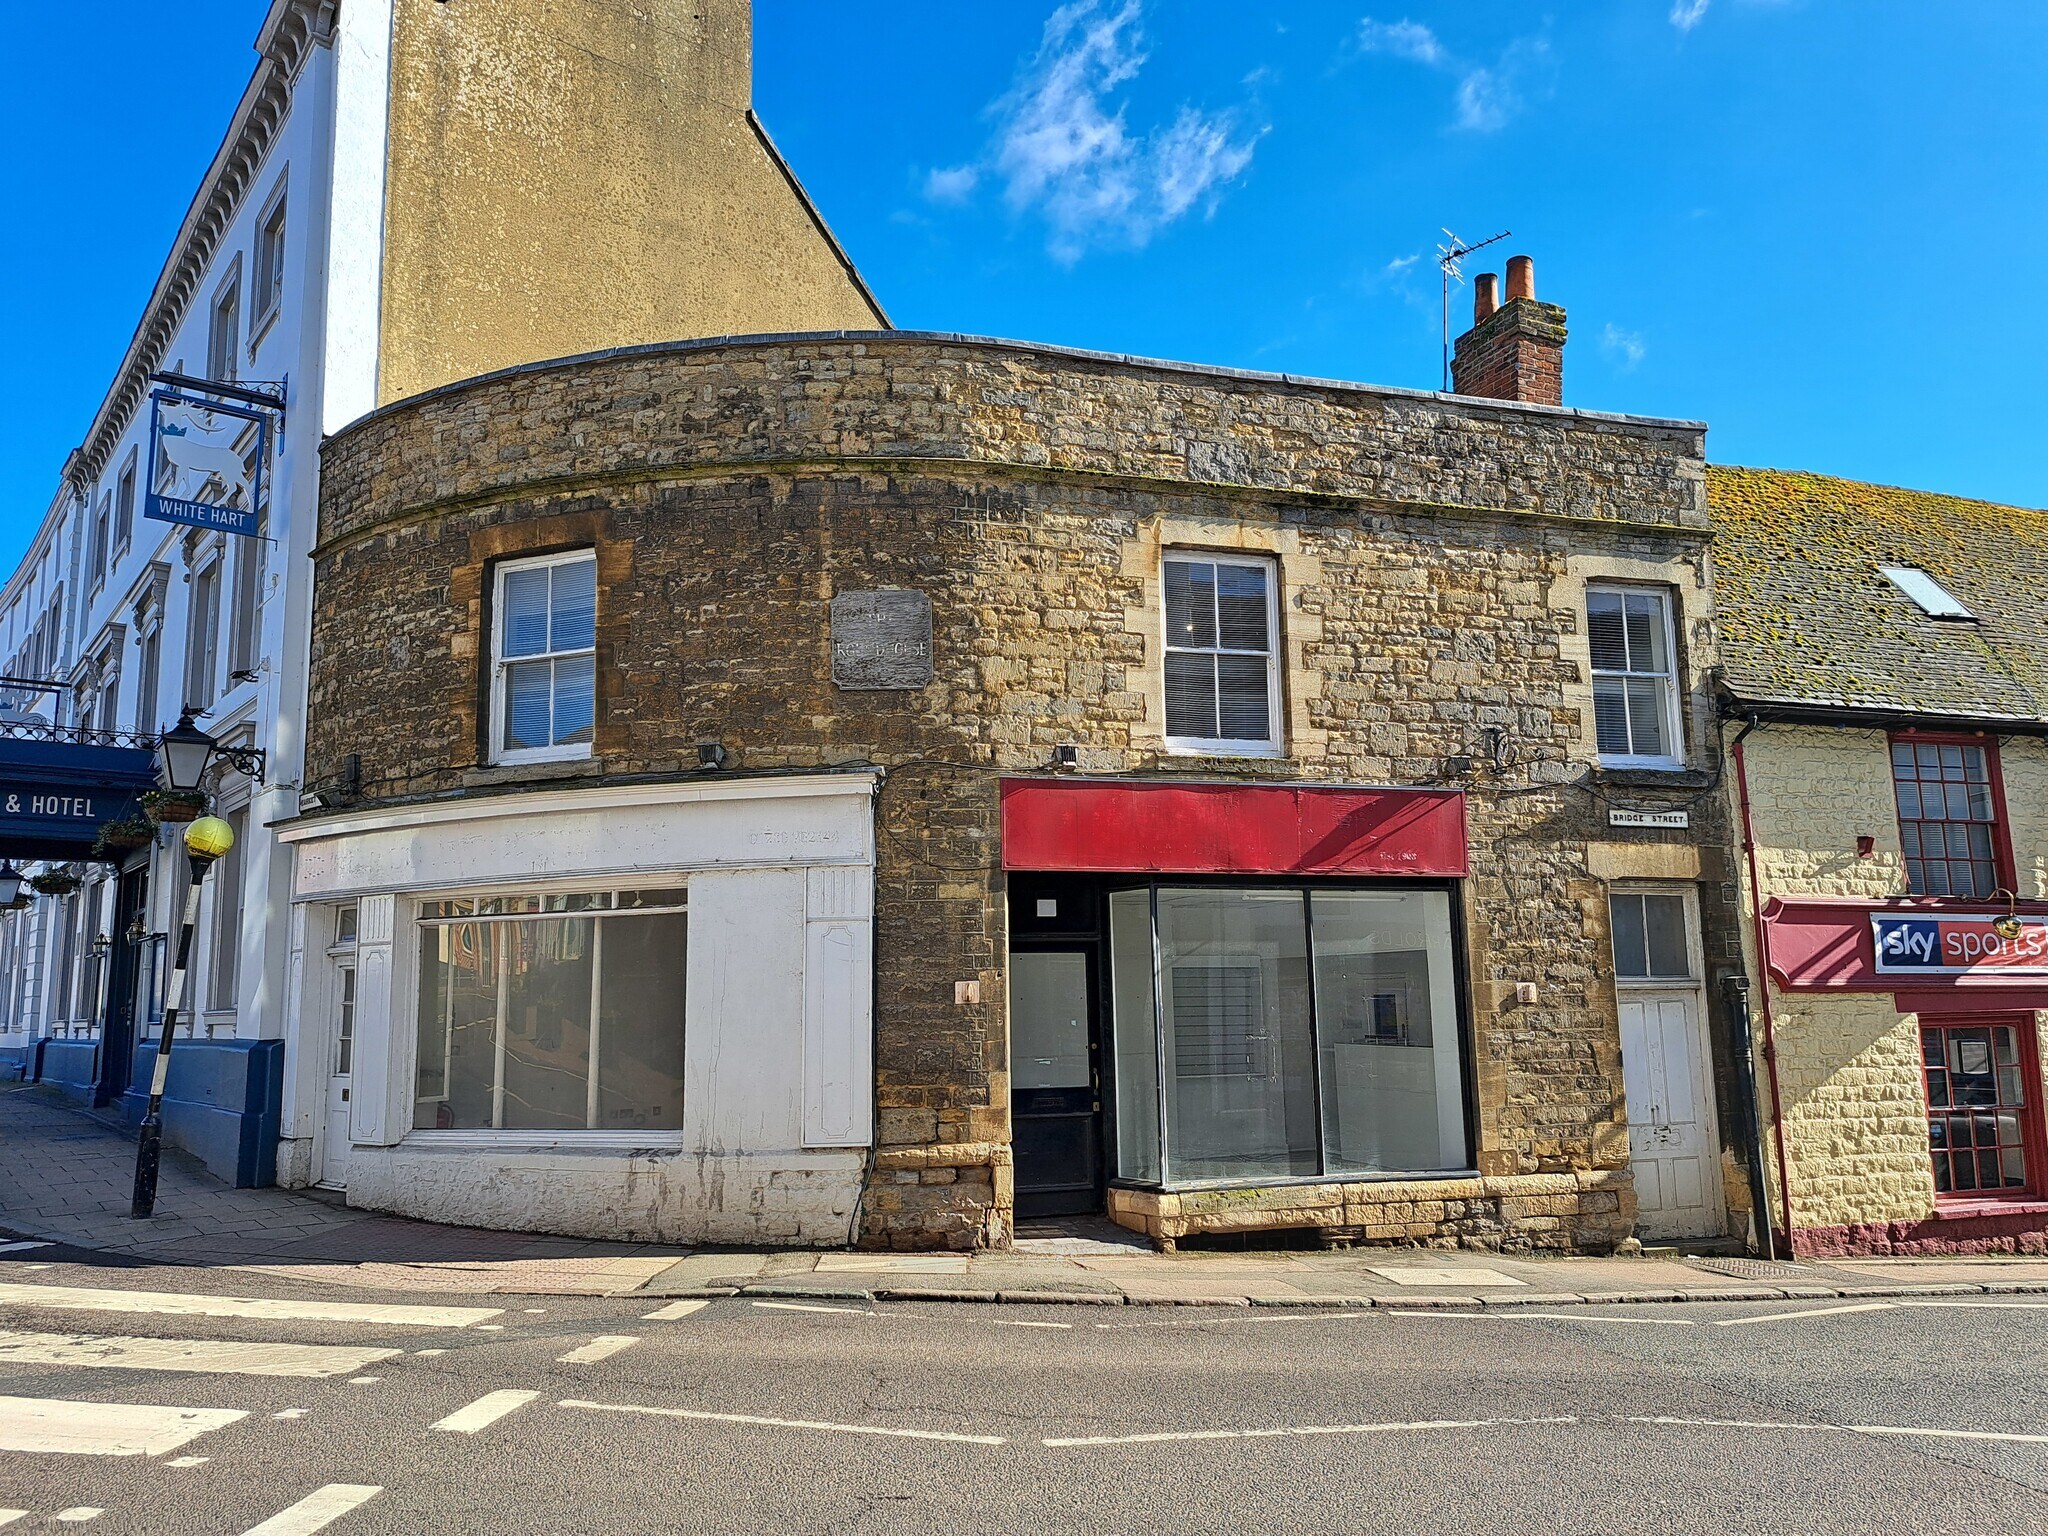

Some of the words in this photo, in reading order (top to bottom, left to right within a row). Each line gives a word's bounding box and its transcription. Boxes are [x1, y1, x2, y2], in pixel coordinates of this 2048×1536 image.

[159, 499, 206, 520] WHITE
[211, 508, 246, 527] HART
[5, 794, 21, 813] &
[31, 795, 95, 817] HOTEL
[1613, 814, 1644, 822] BRIDGE
[1651, 815, 1684, 823] STREET
[1886, 923, 1935, 962] sky
